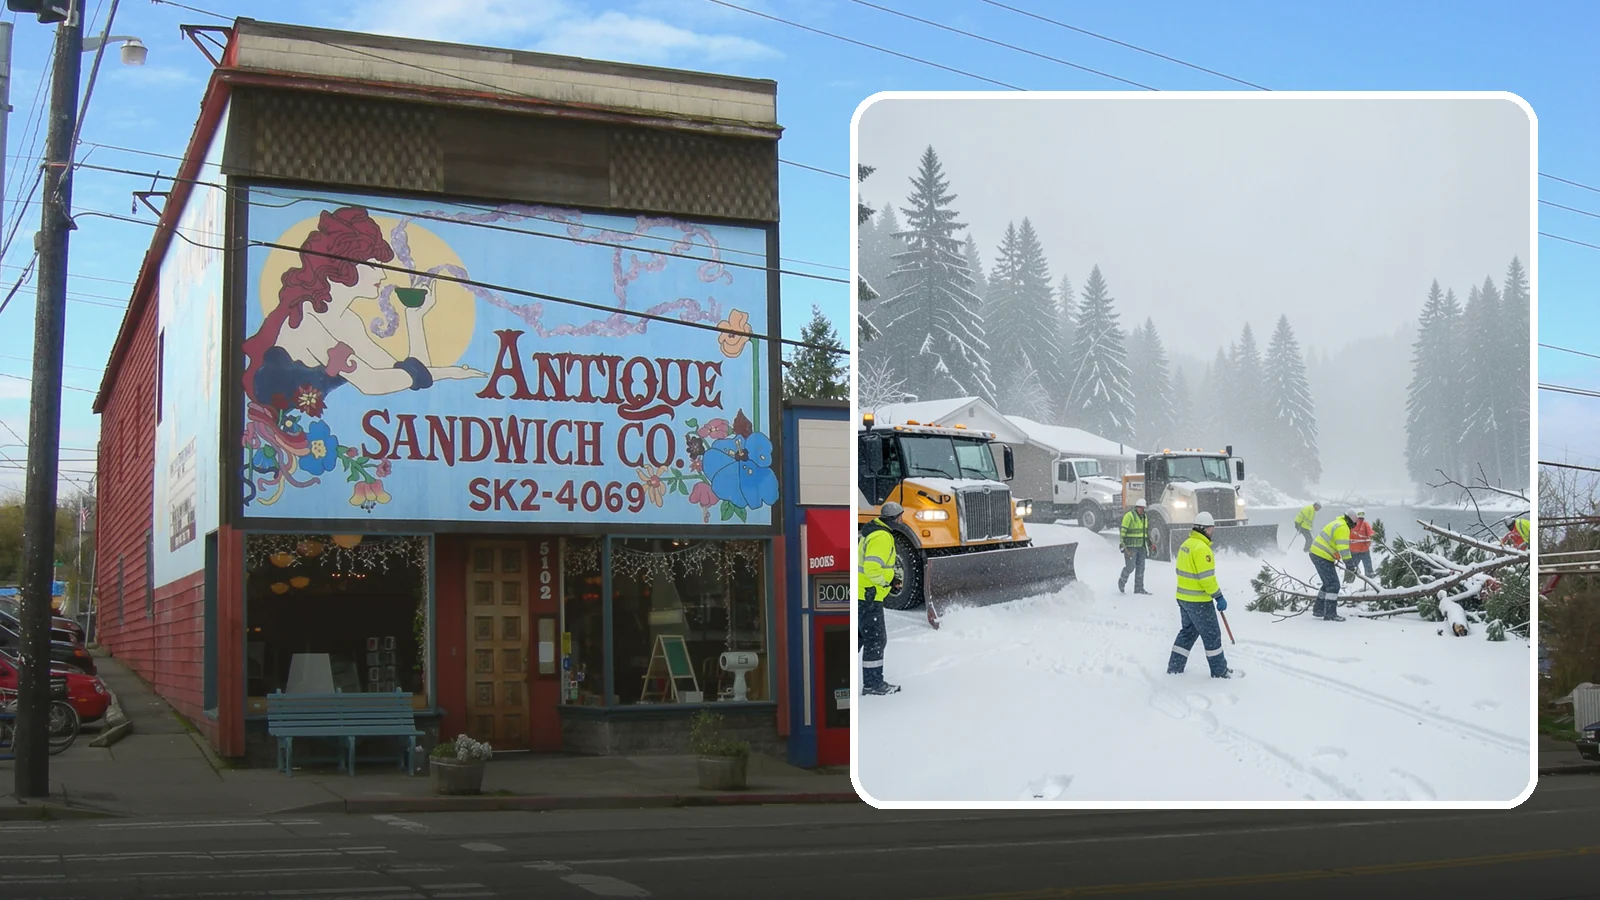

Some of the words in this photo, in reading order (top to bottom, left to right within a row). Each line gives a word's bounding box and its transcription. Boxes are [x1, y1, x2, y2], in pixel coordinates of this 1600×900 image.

[476, 329, 723, 421] ANTIQUE
[362, 408, 604, 467] SANDWICH
[617, 423, 684, 468] CO.
[469, 477, 645, 513] SK2-4069
[540, 542, 551, 599] 5102
[810, 555, 834, 568] BOOKS
